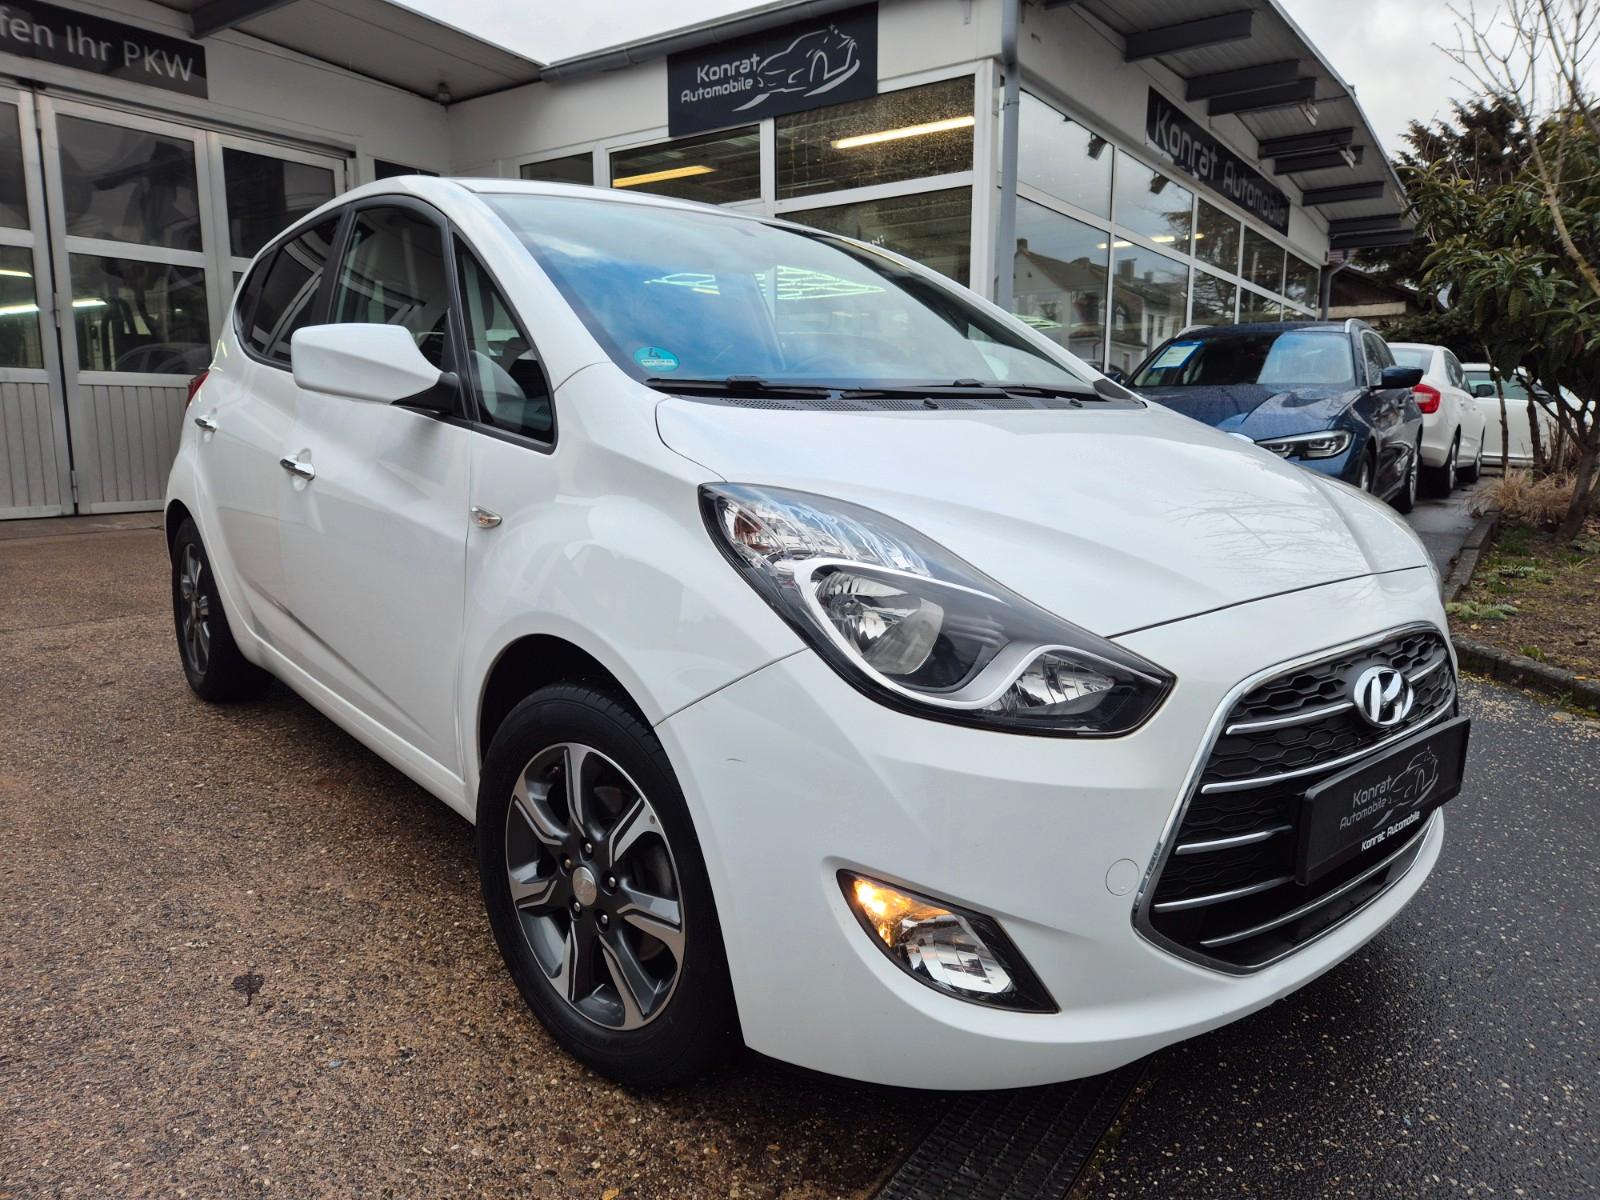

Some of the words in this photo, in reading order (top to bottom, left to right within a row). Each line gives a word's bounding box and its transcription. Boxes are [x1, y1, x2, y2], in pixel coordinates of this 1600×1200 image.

[66, 25, 112, 62] Ihr
[123, 40, 193, 82] PKW
[697, 53, 760, 83] Konrat
[681, 77, 753, 103] Automobile
[1155, 101, 1218, 180] Konrat
[1223, 161, 1286, 227] Automobile
[1353, 776, 1392, 808] Konrat
[1340, 797, 1387, 830] Automobile
[1361, 831, 1386, 852] Konrat
[1387, 811, 1420, 836] Automobile
